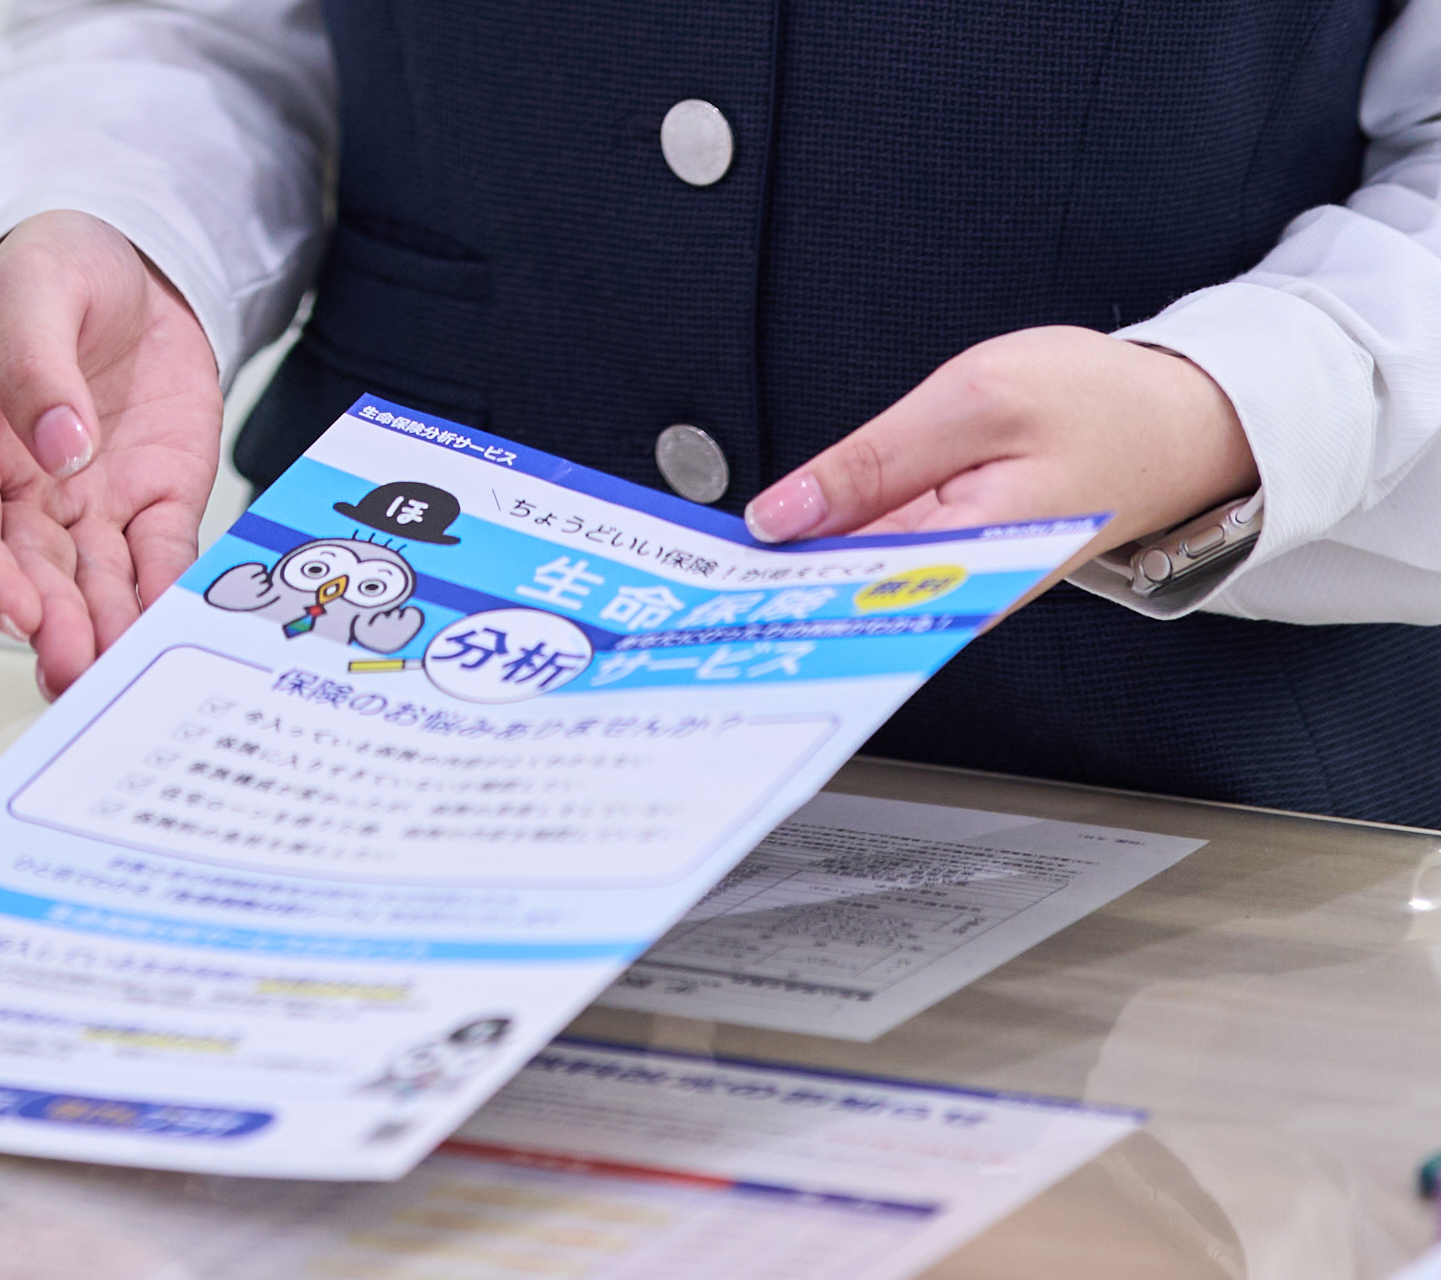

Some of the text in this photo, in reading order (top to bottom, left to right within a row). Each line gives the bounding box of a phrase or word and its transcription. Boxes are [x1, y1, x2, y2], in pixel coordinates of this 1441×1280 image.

[358, 404, 519, 466] 生命保険分析サービス
[385, 495, 430, 525] ほ
[516, 555, 838, 630] 生命保険
[431, 627, 816, 690] 分析 サービス
